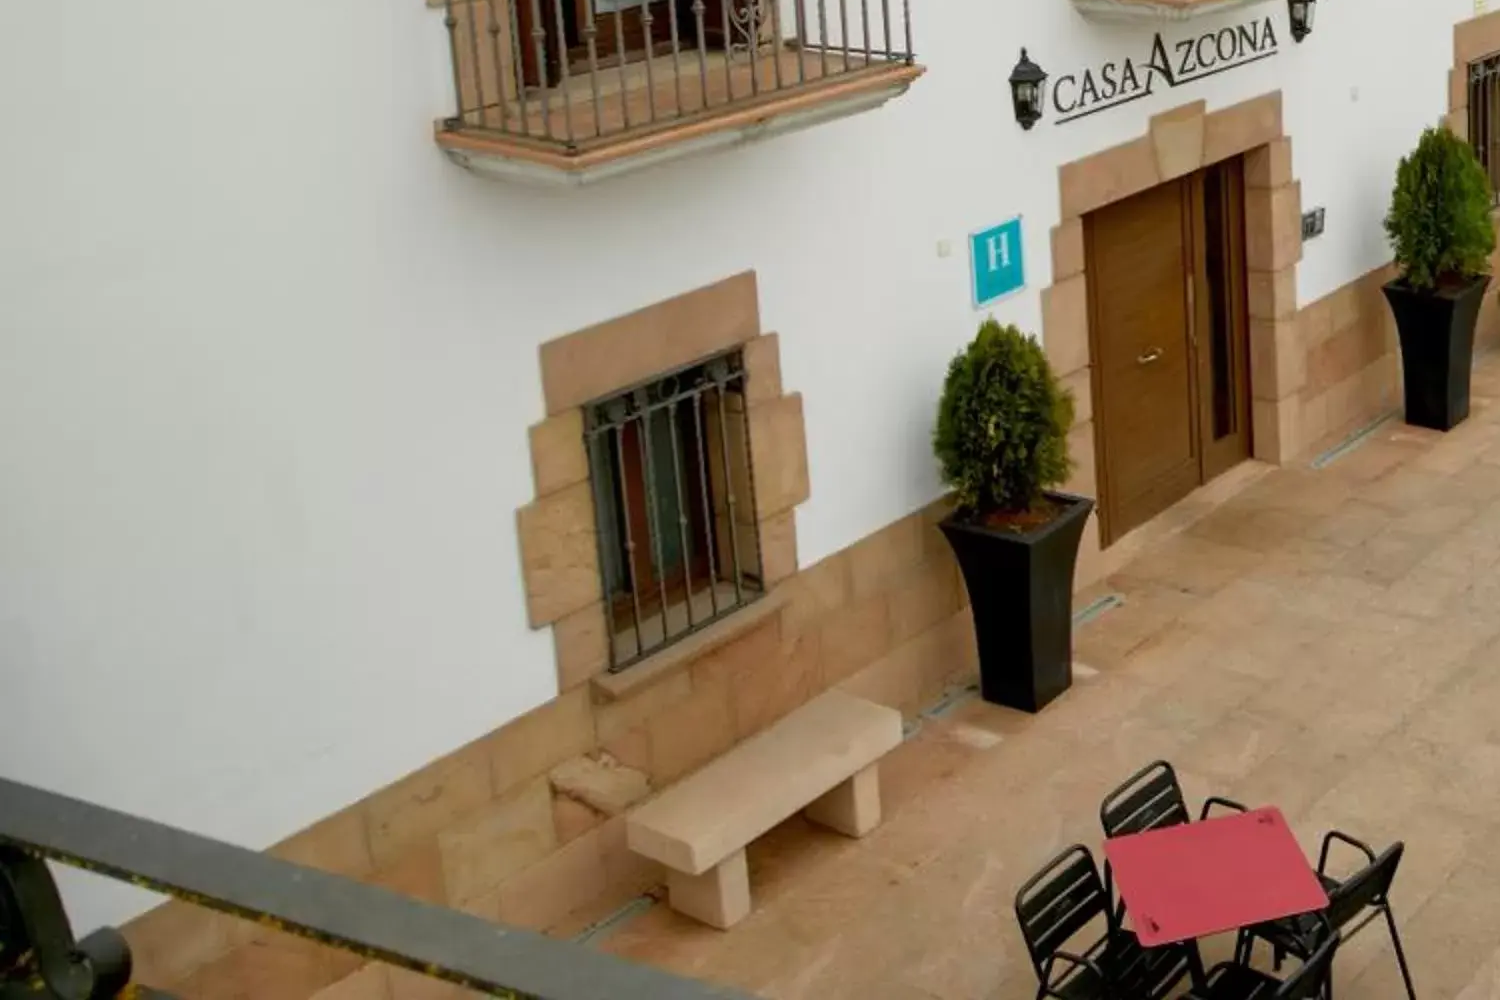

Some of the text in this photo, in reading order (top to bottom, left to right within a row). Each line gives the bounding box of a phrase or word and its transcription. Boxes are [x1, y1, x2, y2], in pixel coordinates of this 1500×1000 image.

[1053, 17, 1278, 114] CASA AZCONA
[988, 231, 1011, 272] H
